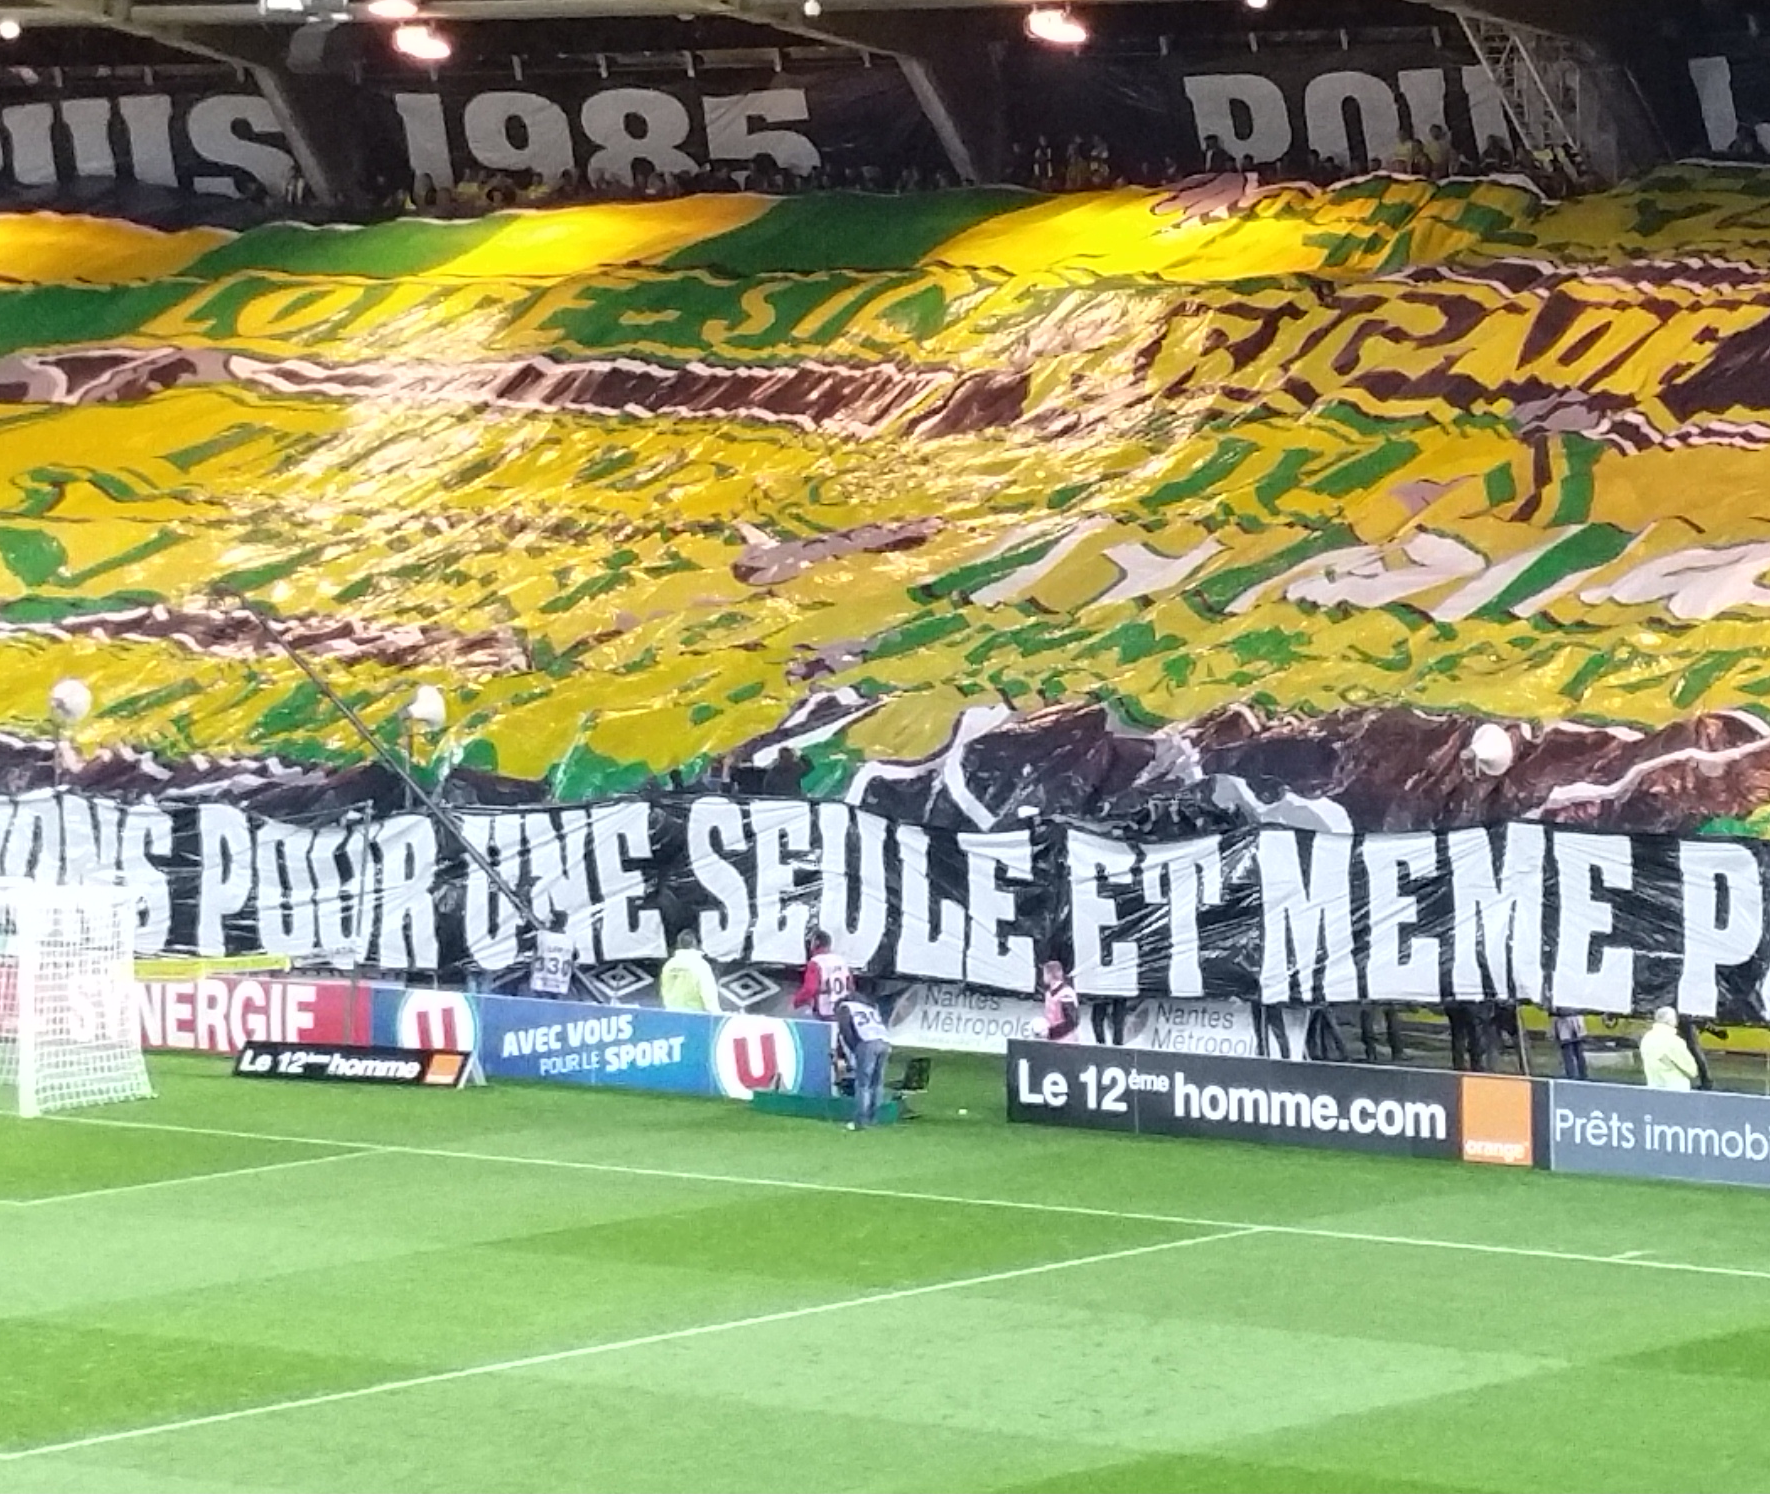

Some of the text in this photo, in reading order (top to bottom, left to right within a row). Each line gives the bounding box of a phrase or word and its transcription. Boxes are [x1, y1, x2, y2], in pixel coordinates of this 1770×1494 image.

[395, 88, 820, 201] 1985
[198, 803, 438, 971] POUR
[463, 801, 669, 971] UNE
[689, 797, 1035, 990] SEULE
[1066, 829, 1227, 997] ET
[1258, 823, 1633, 1013] MEME
[502, 1014, 633, 1058] AVEC VOUS
[1155, 1002, 1234, 1031] Nantes
[239, 1049, 272, 1072] Le
[329, 1054, 421, 1079] homme
[605, 1036, 685, 1073] SPORT
[1017, 1059, 1068, 1106] Le
[1174, 1072, 1447, 1140] homme.com
[1554, 1108, 1633, 1150] Prêts
